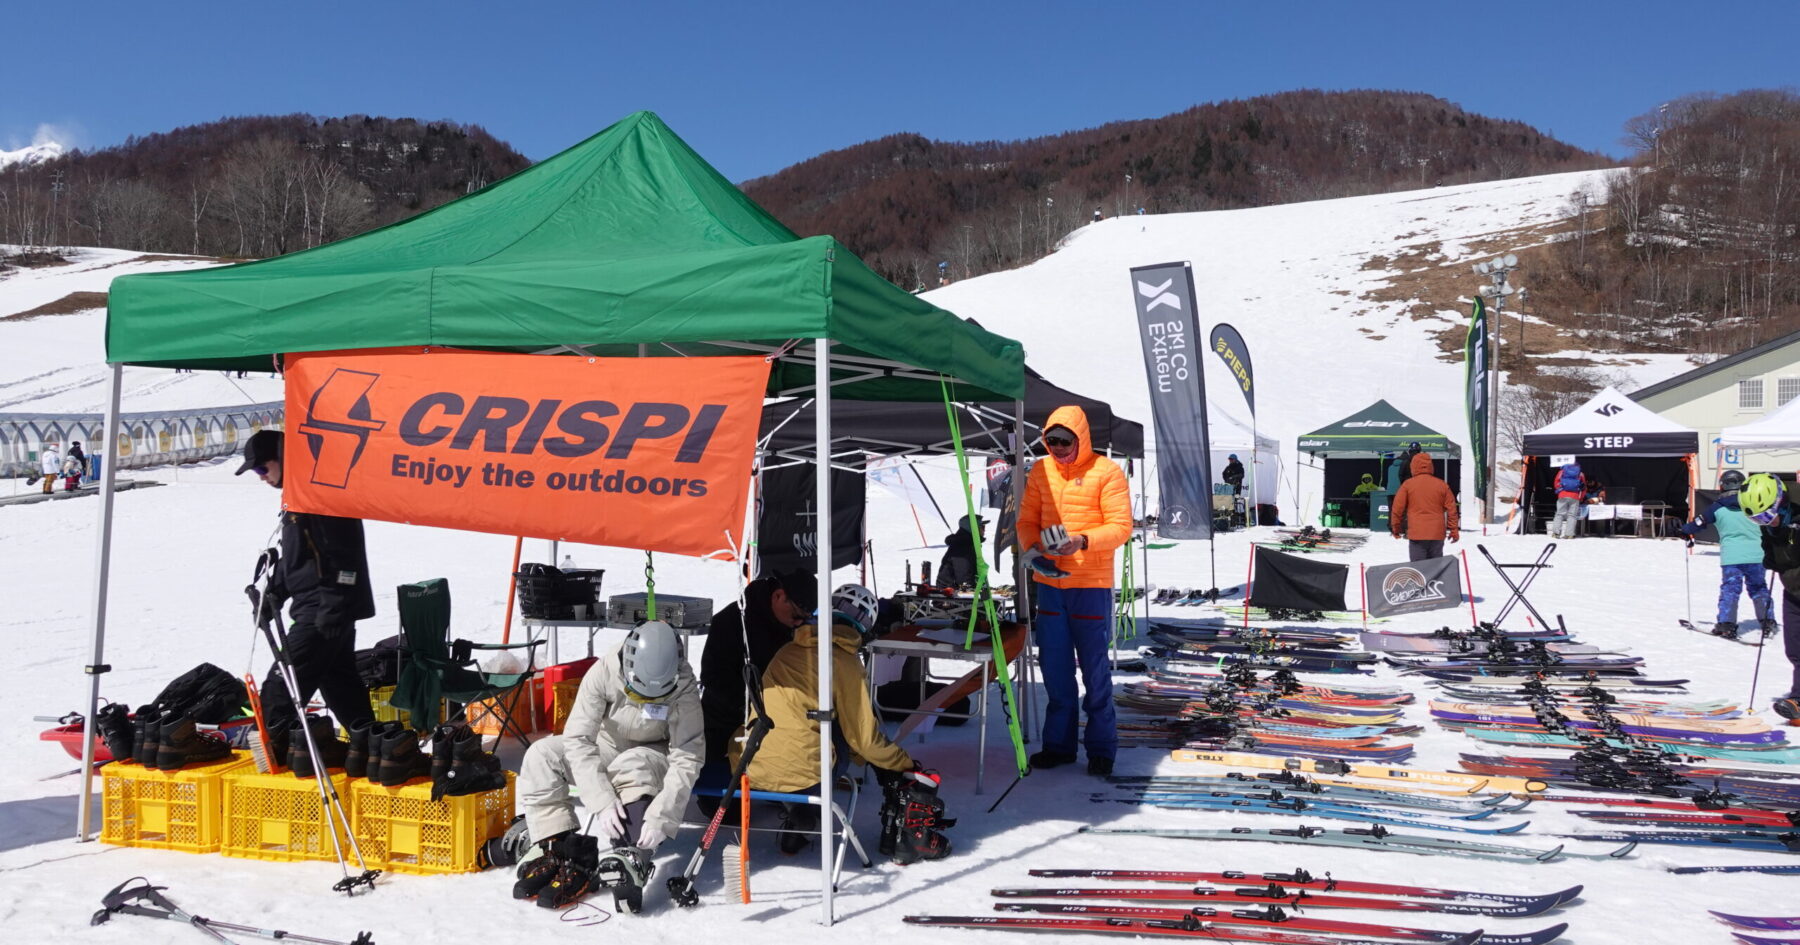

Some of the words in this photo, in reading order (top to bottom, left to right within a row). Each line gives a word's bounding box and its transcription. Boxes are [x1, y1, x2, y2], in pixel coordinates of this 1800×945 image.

[1223, 347, 1251, 393] PIEPS
[398, 391, 728, 464] CRISPI
[1342, 420, 1410, 428] elan
[1583, 436, 1634, 449] STEEP
[391, 454, 473, 490] Enjoy
[481, 462, 535, 489] the
[540, 469, 708, 498] outdoors
[1444, 905, 1528, 913] MADSHUS
